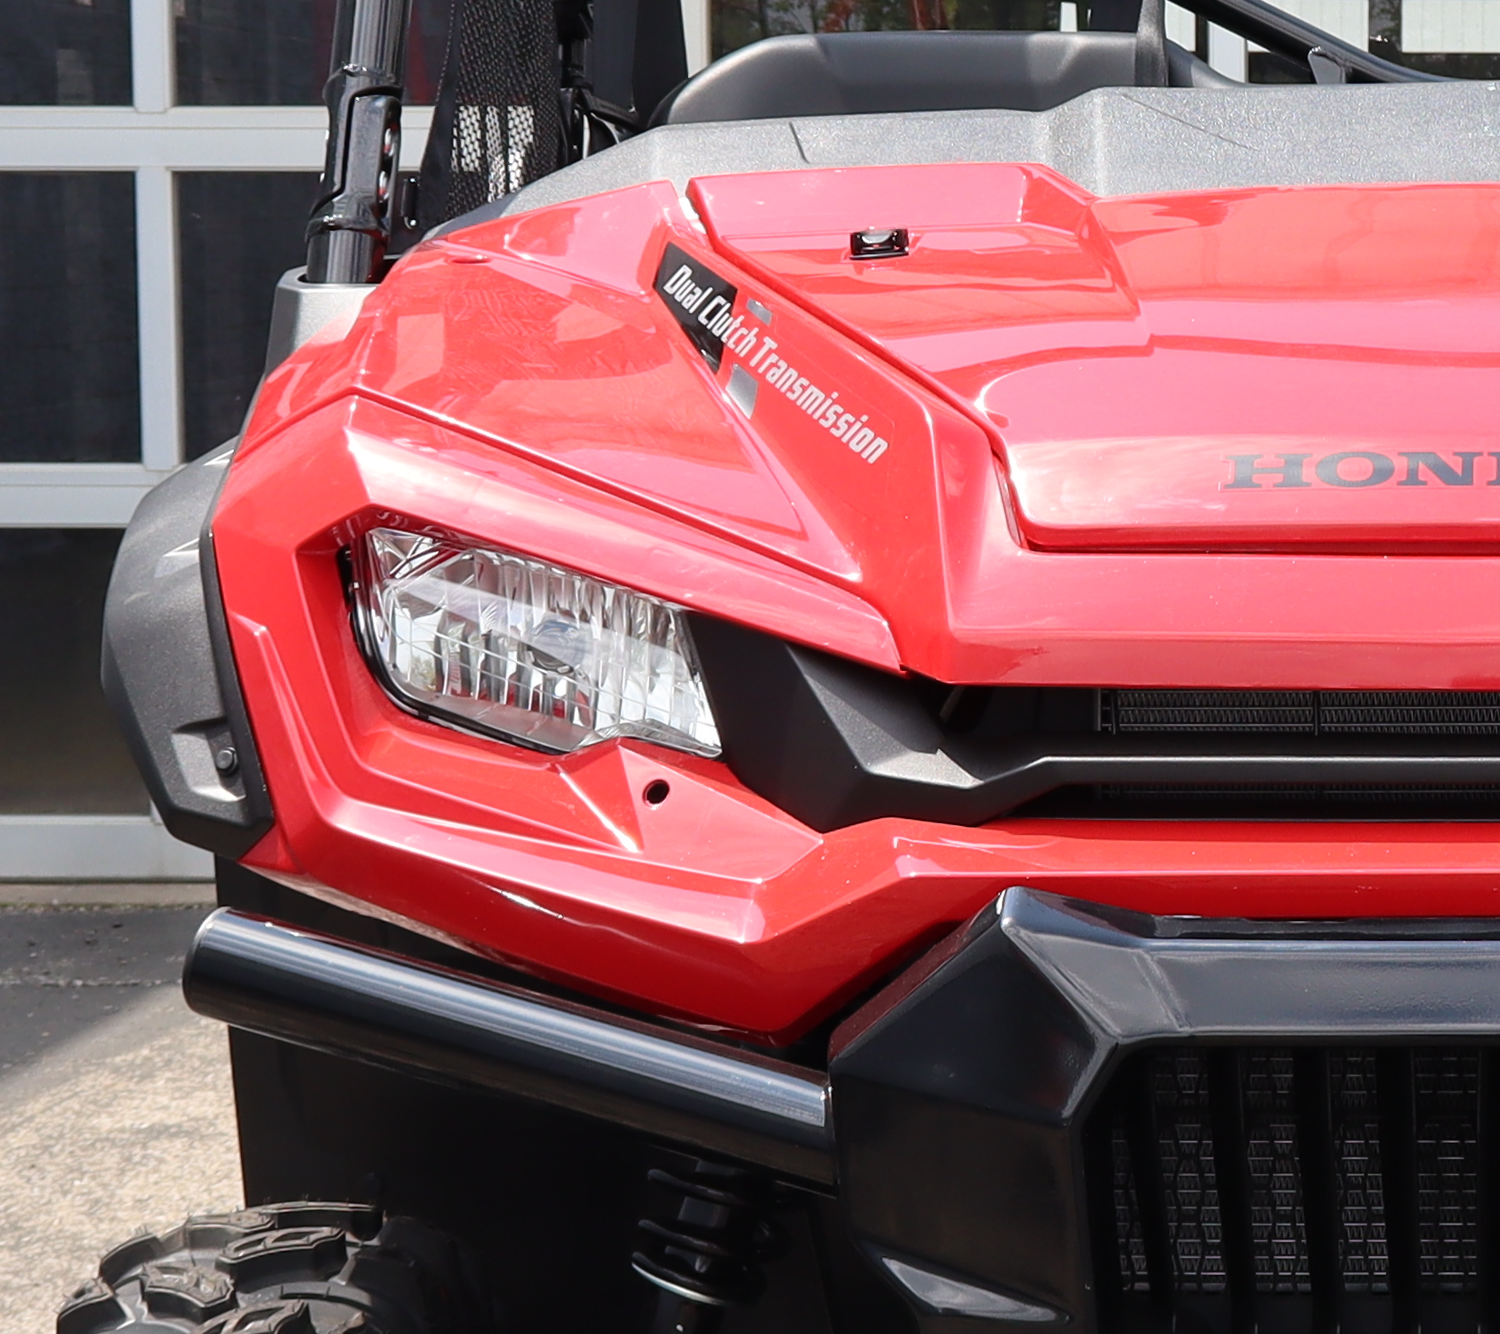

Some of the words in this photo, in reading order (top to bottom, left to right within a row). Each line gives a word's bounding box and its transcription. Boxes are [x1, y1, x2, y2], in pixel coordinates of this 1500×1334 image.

[663, 264, 713, 314] Dual
[697, 294, 760, 358] Clutch
[749, 335, 889, 465] Transmission
